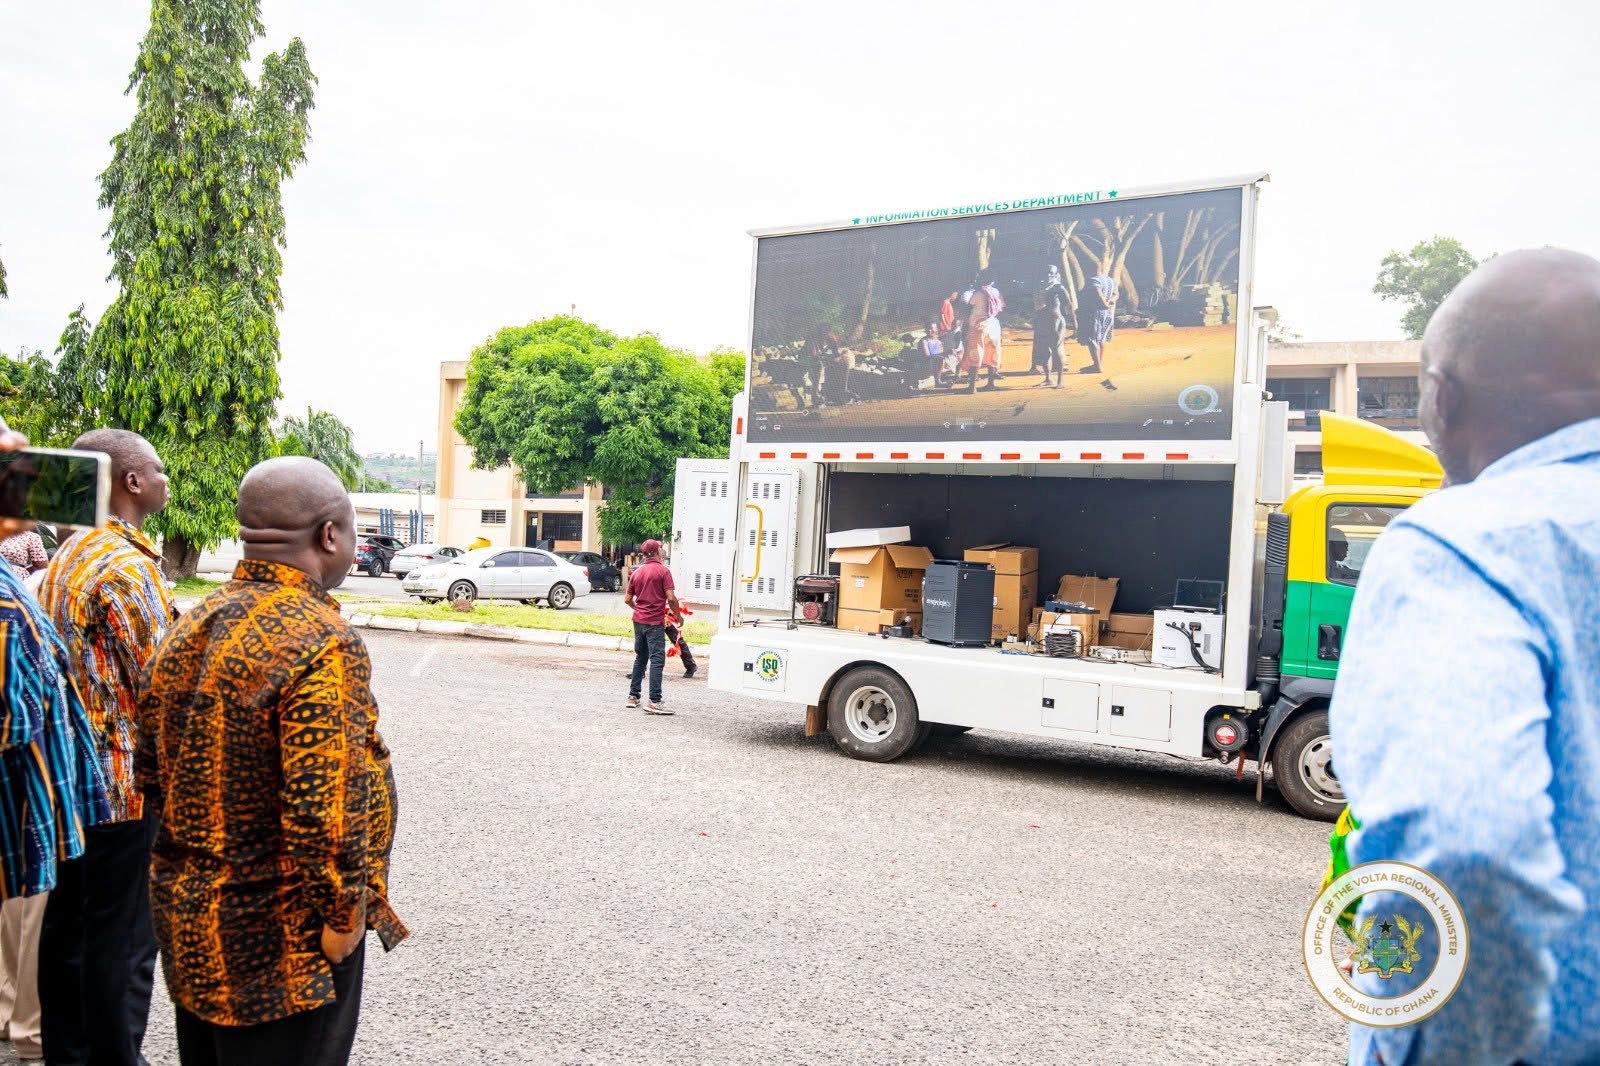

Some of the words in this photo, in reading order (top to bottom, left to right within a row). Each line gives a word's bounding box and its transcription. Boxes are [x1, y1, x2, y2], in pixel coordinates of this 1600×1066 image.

[866, 207, 949, 223] INFORMATION
[951, 201, 1009, 214] SERVICES
[1012, 191, 1102, 209] DEPARTMENT
